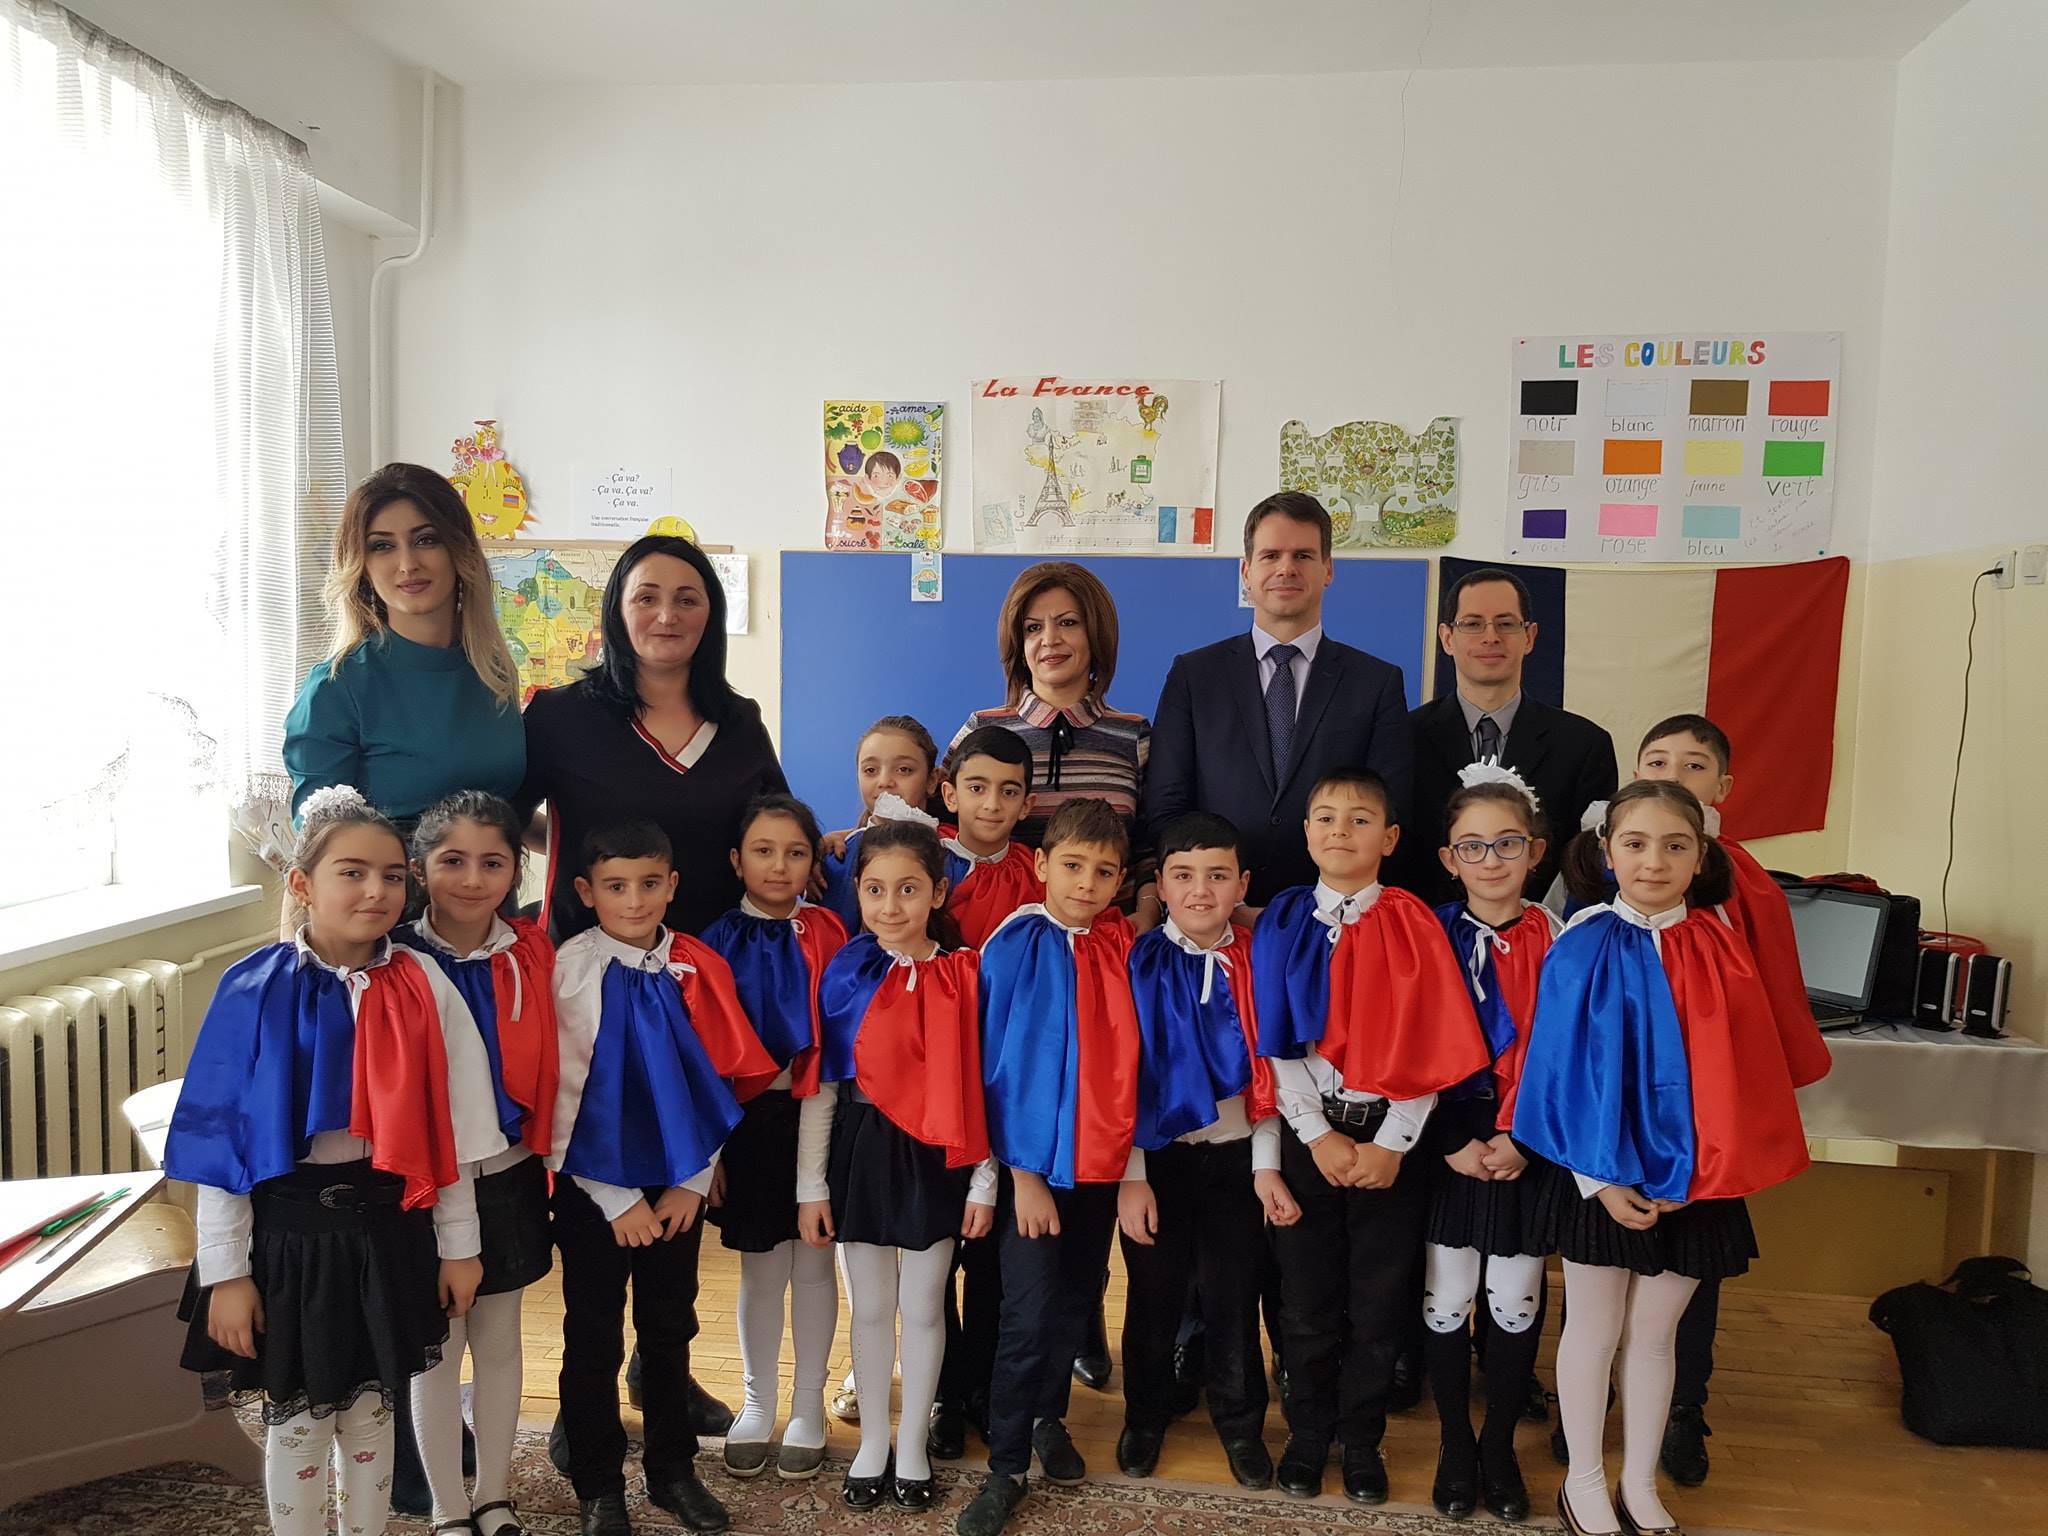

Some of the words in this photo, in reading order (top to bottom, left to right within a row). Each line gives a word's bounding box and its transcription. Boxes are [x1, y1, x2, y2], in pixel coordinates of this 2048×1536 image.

[1558, 343, 1615, 369] LES
[1624, 340, 1766, 367] COULEURS
[982, 379, 1019, 398] La
[1032, 376, 1155, 398] France
[838, 404, 869, 414] acide
[899, 405, 931, 414] amer
[1526, 416, 1568, 432] noir
[1611, 418, 1655, 432] blanc
[1688, 416, 1745, 433] marron
[1771, 418, 1820, 440] rouge
[611, 473, 624, 483] Ça
[625, 474, 640, 482] va?
[597, 485, 610, 495] Ça
[625, 486, 638, 496] Ça
[640, 486, 654, 495] va?
[1516, 474, 1561, 500] gris
[1605, 477, 1659, 500] orange
[1685, 479, 1727, 497] jaune
[1767, 476, 1815, 497] vert
[612, 498, 625, 508] Ça
[836, 538, 867, 548] sucré
[900, 539, 925, 549] salé
[1600, 538, 1647, 554] rose
[1687, 540, 1725, 556] bleu
